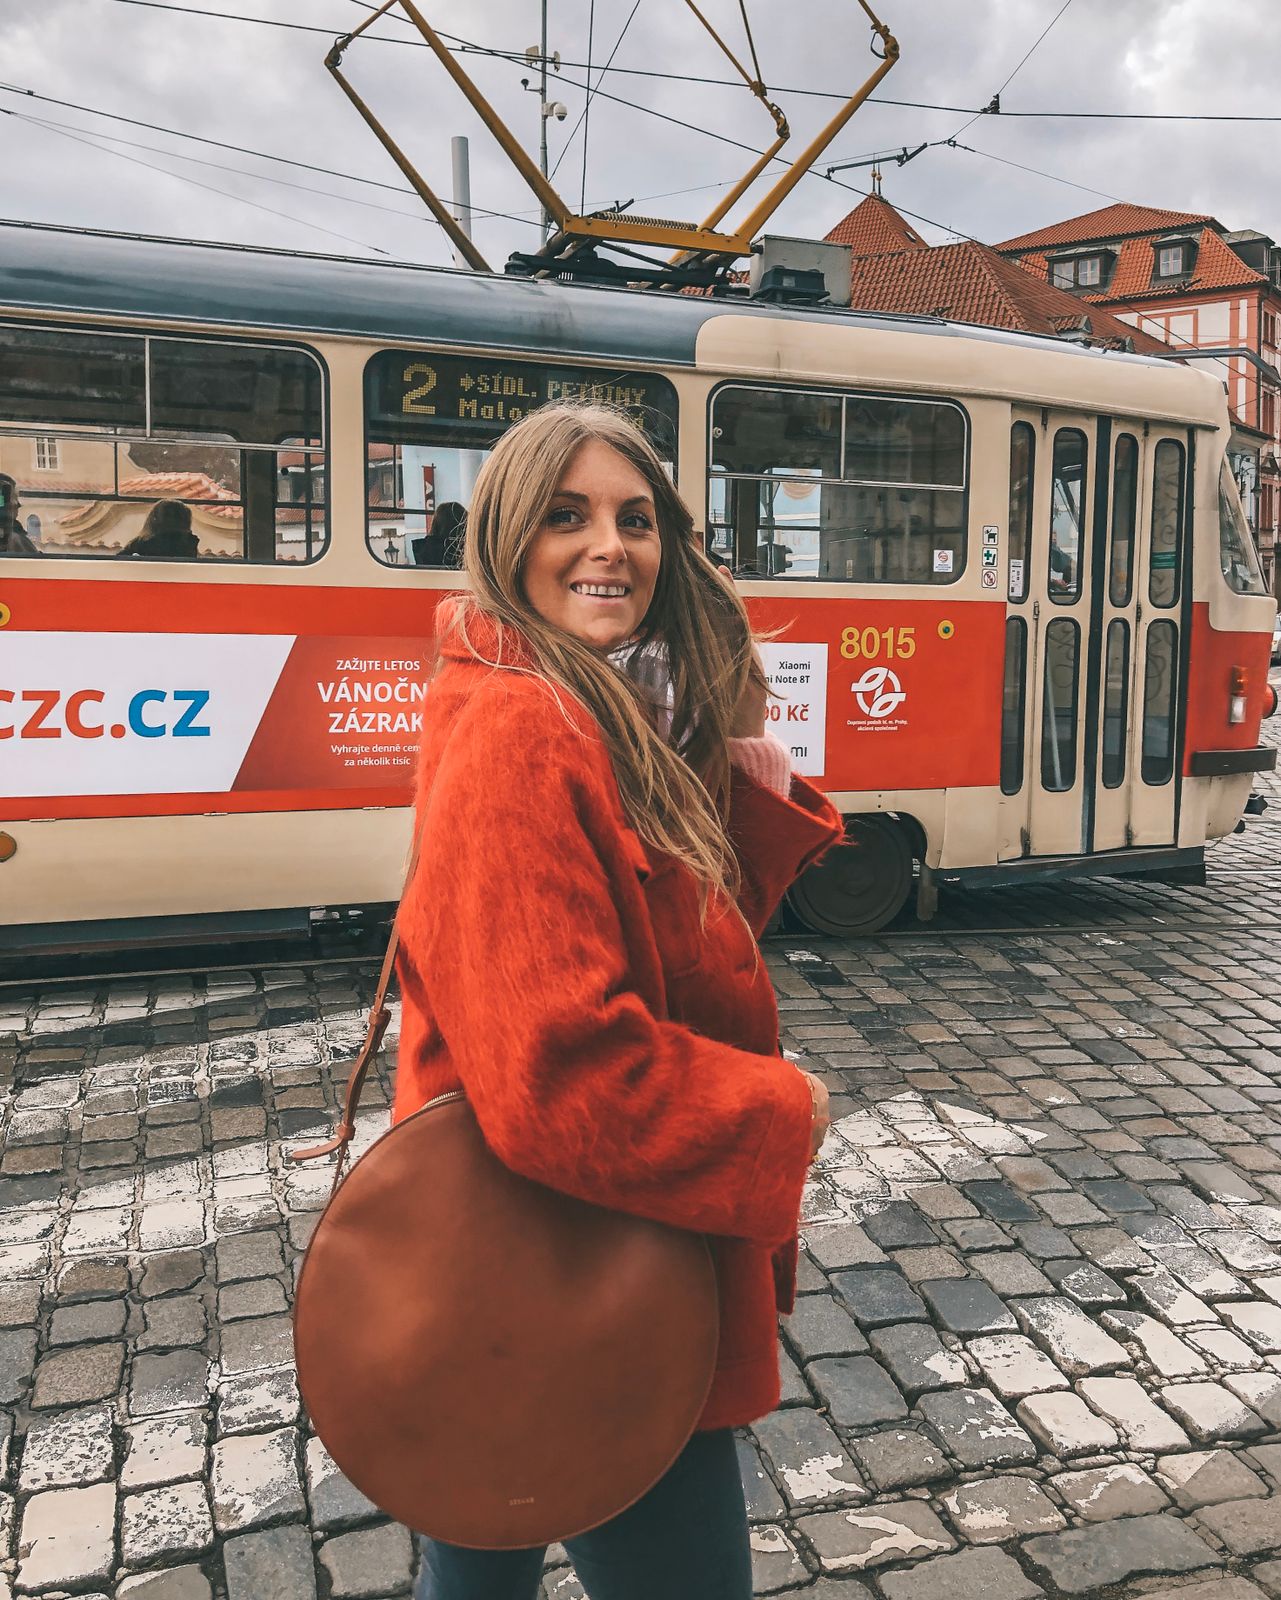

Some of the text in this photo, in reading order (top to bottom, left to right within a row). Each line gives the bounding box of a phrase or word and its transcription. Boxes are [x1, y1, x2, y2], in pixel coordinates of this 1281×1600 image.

[402, 363, 437, 415] 2
[840, 626, 916, 659] 8015
[336, 657, 420, 672] ZAŽIJTE LETOS
[778, 661, 811, 670] Xiaomi
[775, 674, 797, 684] Note
[799, 675, 811, 684] 8T
[317, 676, 428, 703] VÁNOČN
[328, 707, 424, 733] ZÁZRAK
[787, 704, 810, 721] Kč
[331, 743, 421, 755] Vyhrajte denně cen
[344, 756, 411, 766] za několik tisíc
